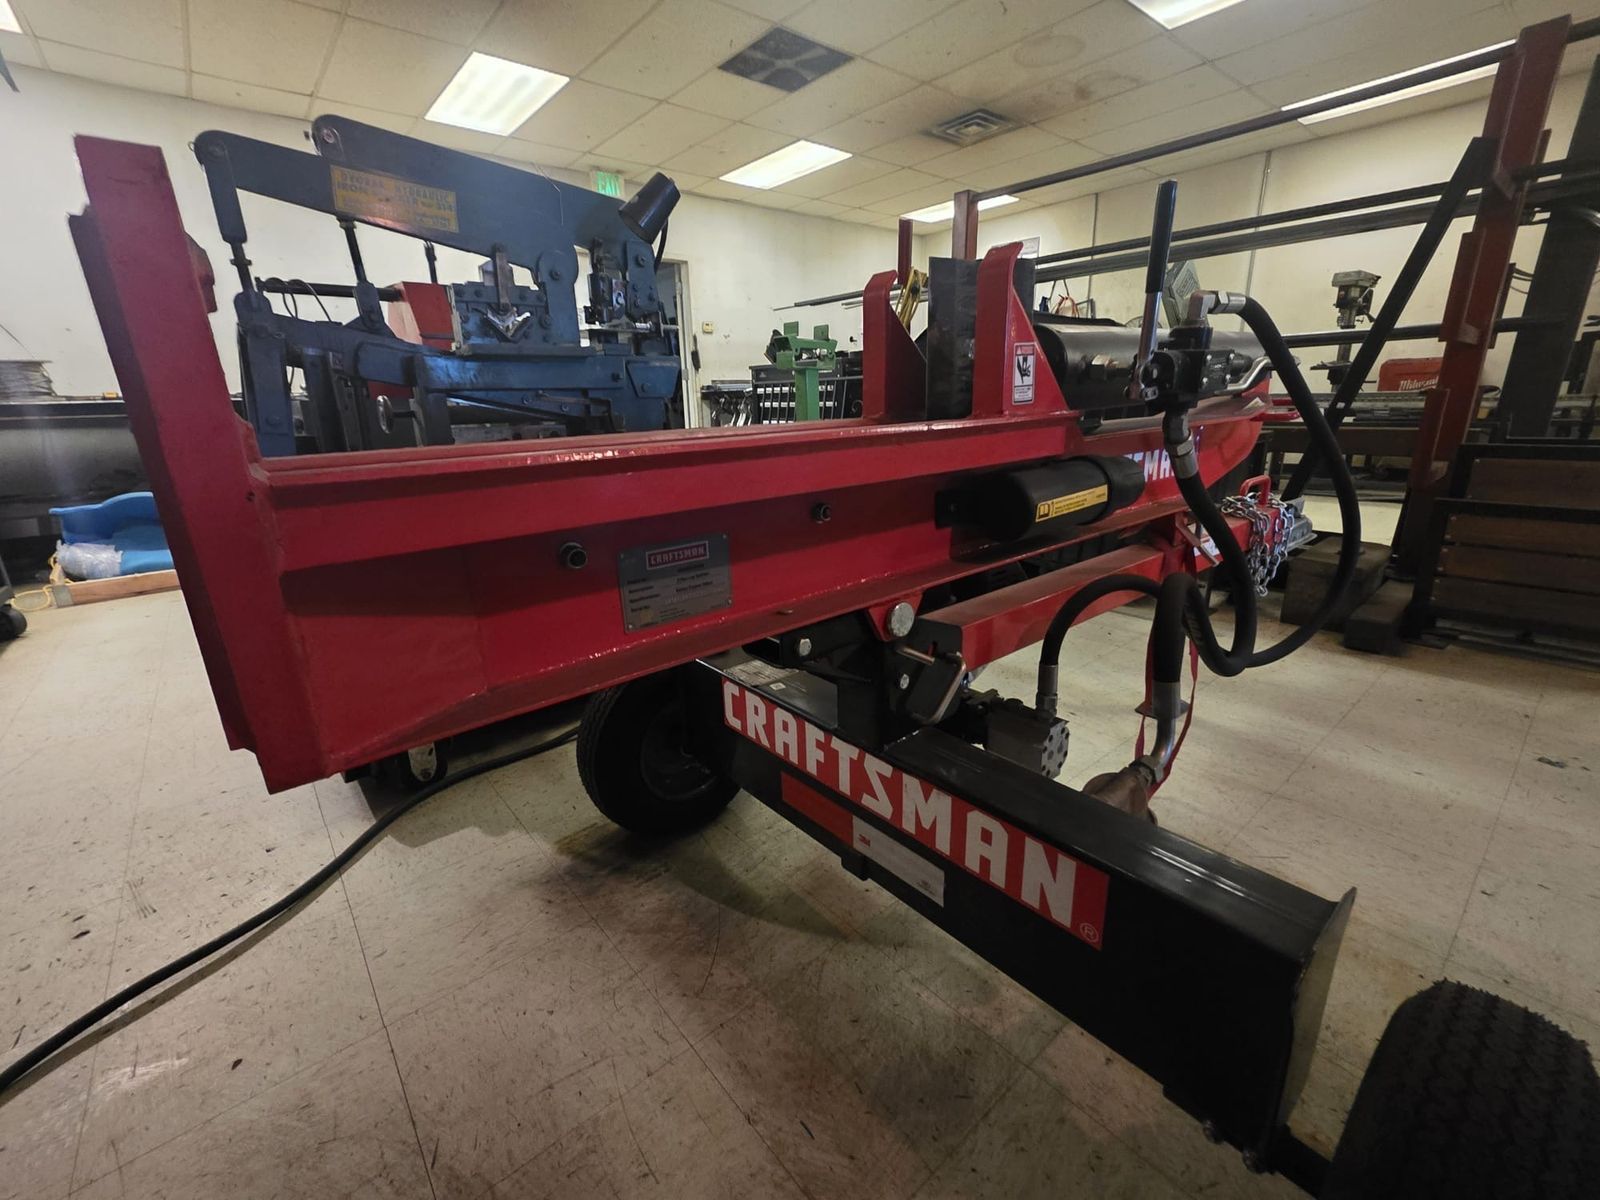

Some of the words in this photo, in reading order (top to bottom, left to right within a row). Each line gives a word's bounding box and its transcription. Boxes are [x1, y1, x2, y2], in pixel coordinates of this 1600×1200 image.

[596, 171, 621, 197] EXIT
[650, 545, 705, 565] CRAFTSMAN
[723, 680, 1077, 928] CRAFTSMAN
